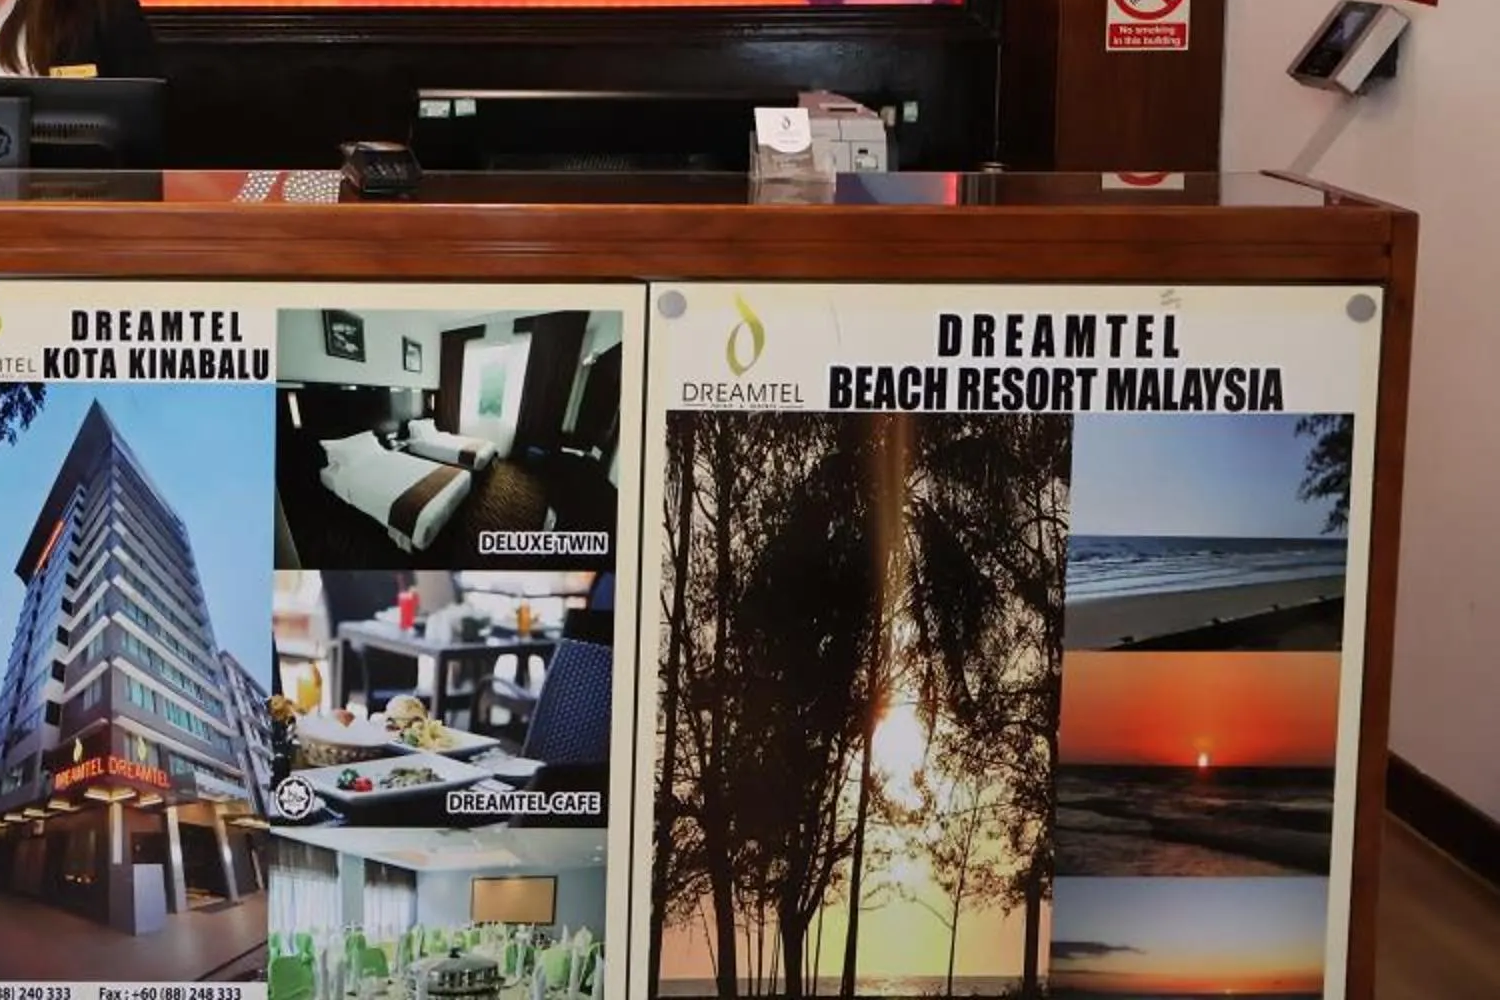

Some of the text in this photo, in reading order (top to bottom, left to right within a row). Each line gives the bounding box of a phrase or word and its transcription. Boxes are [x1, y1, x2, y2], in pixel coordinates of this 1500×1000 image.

[1119, 24, 1176, 37] No smoking
[1124, 35, 1141, 46] this
[1143, 35, 1181, 47] building
[71, 310, 243, 342] DREAMTEL
[937, 313, 1180, 359] DREAMTEL
[43, 347, 269, 381] KOTA KINABALU
[682, 382, 805, 403] DREAMTEL
[829, 366, 1284, 412] BEACH RESORT MALAYSIA
[481, 533, 605, 551] DELUXE TWIN
[449, 794, 599, 812] DREAMTEL CAFE
[19, 987, 44, 1000] 240
[47, 987, 71, 1000] 333
[99, 987, 122, 1000] Fax
[131, 987, 157, 1000] +60
[218, 987, 242, 1000] 333
